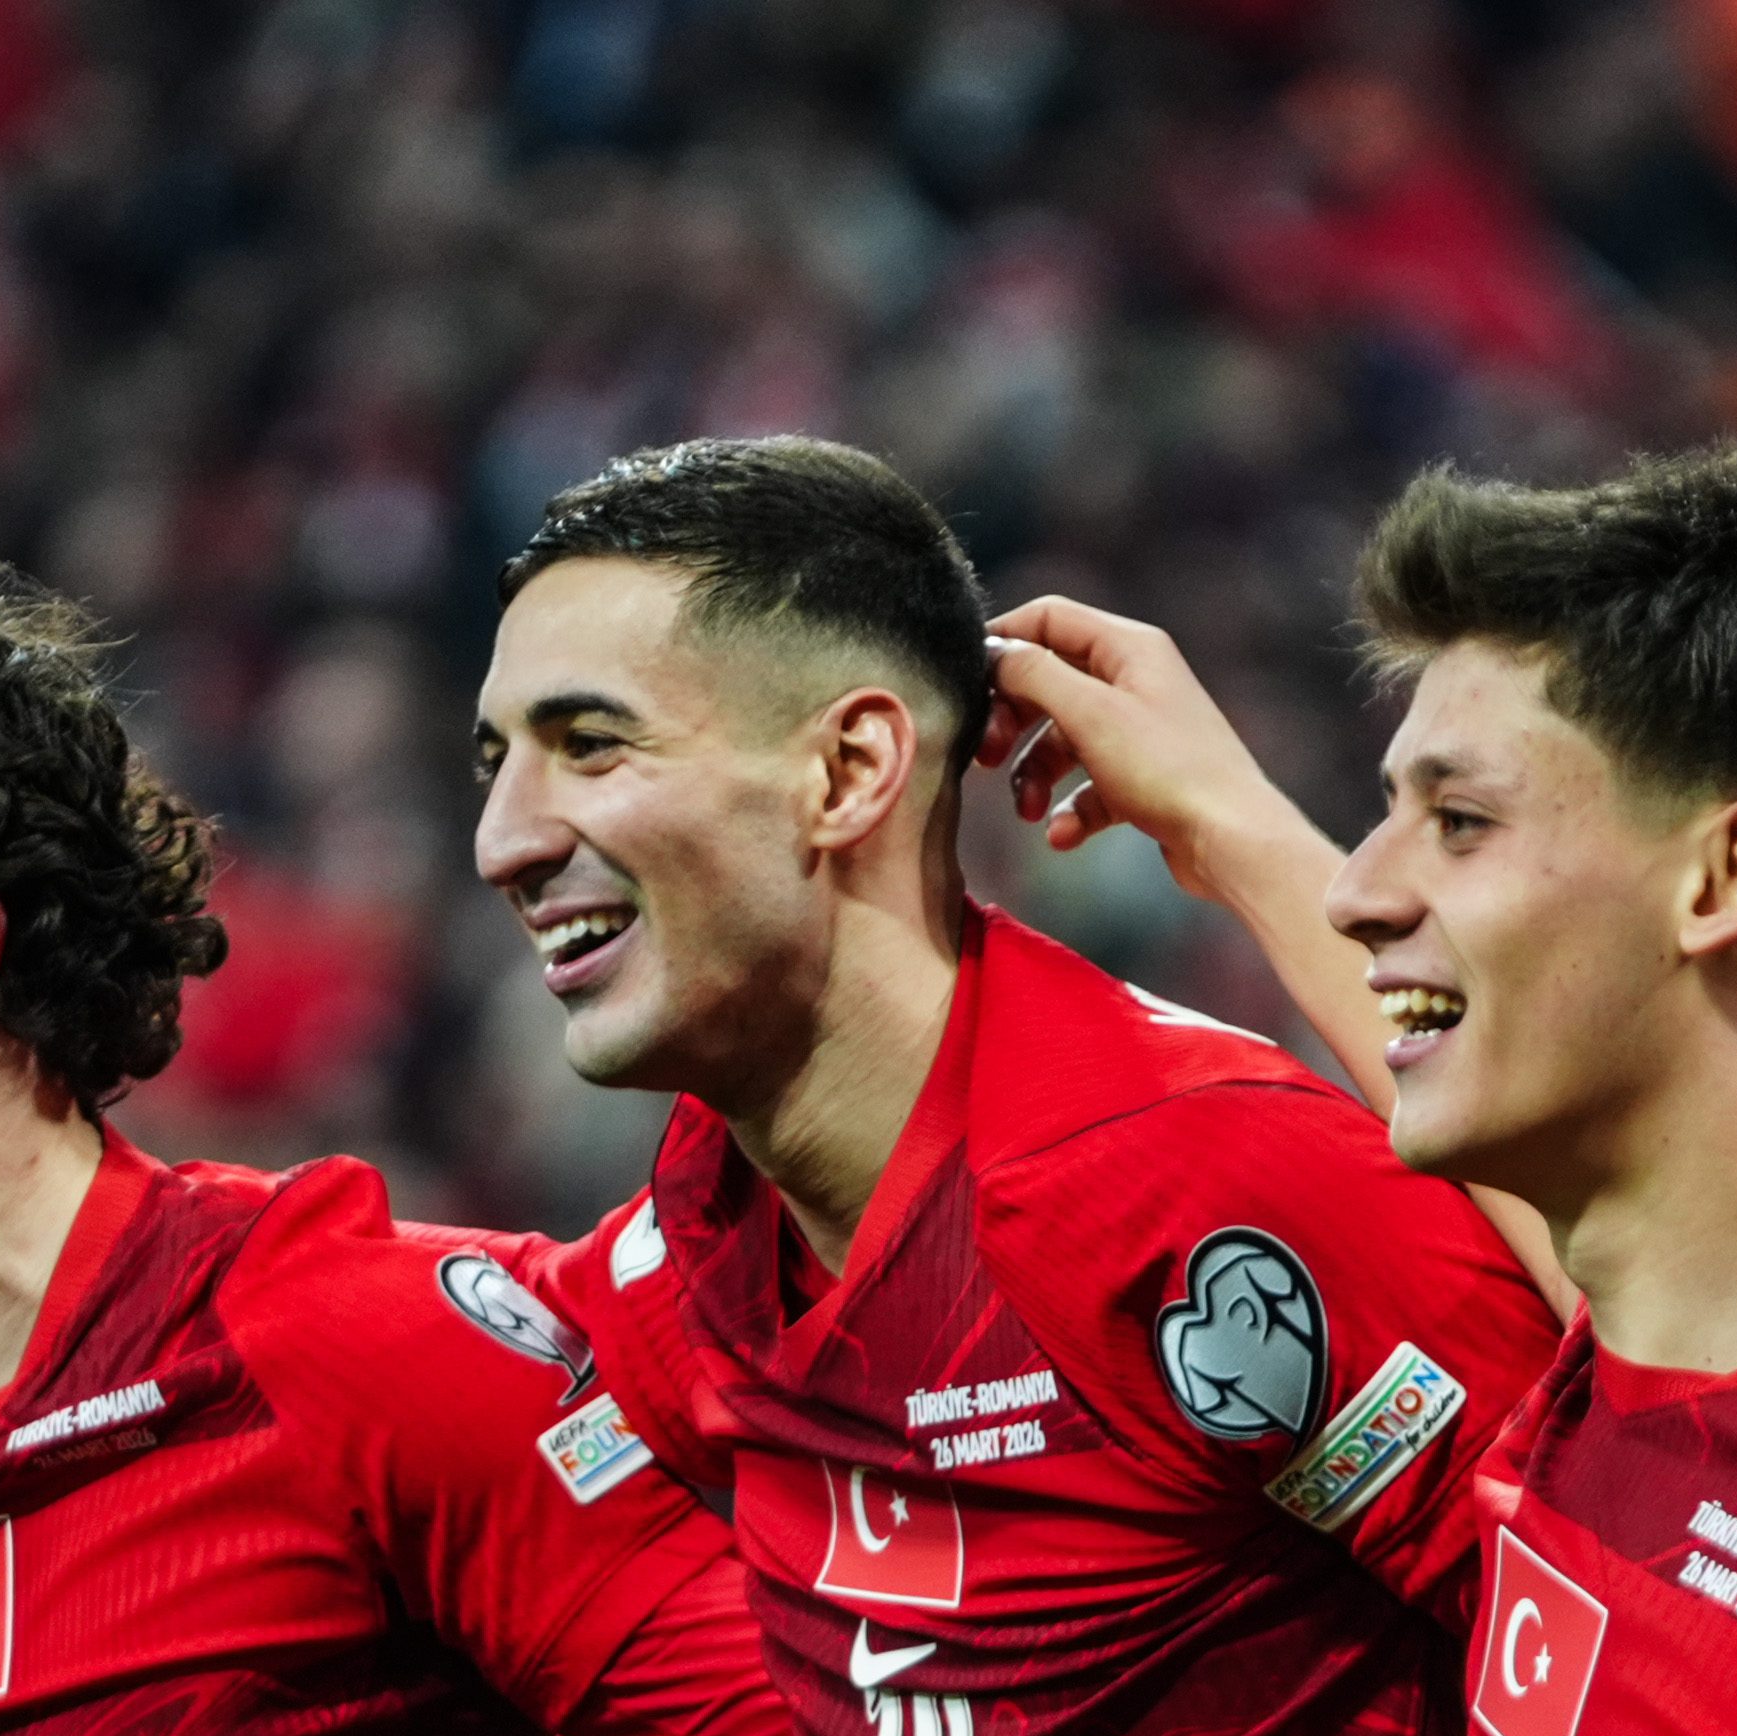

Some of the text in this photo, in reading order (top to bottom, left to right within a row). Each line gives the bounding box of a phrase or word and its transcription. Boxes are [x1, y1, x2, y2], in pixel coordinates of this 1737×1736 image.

[905, 1369, 1059, 1428] TÜRKİYE-ROMANYA
[930, 1419, 1047, 1470] 26 MART 2026
[1285, 1362, 1442, 1519] FOUNDATION
[1678, 1550, 1708, 1585] 26
